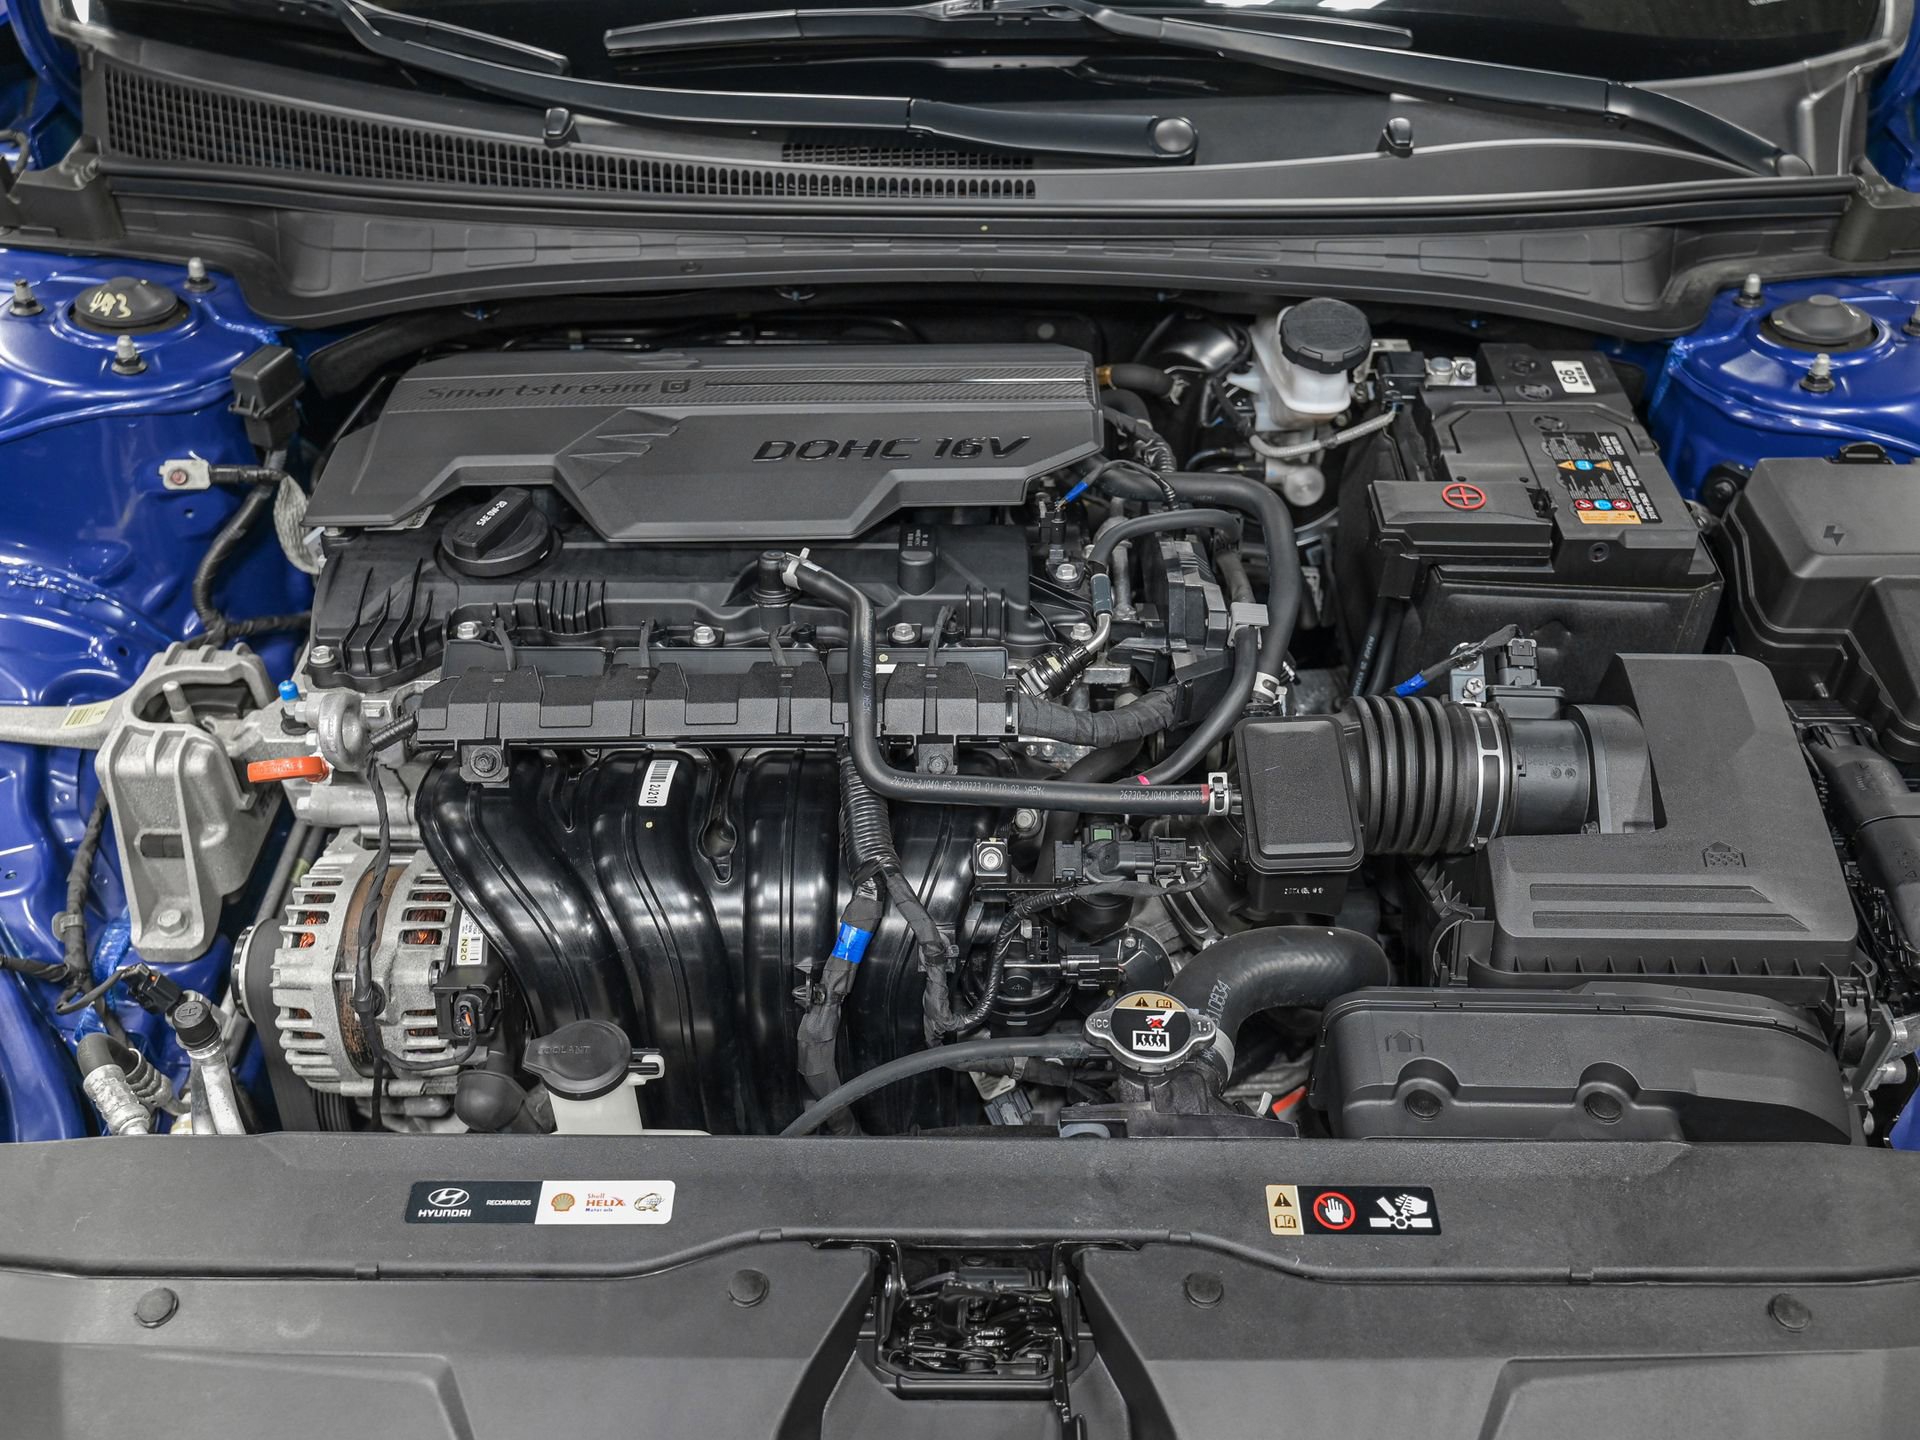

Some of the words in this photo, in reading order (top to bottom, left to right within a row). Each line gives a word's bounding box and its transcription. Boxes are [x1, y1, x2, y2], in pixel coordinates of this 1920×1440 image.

[1559, 369, 1579, 385] G6
[425, 381, 652, 400] Smartstream
[752, 438, 921, 463] DOHC
[934, 435, 1032, 459] 16V
[476, 515, 492, 527] SAE
[646, 784, 661, 804] 2J210
[1119, 790, 1167, 801] 26730-2J040
[1170, 790, 1180, 801] HS
[460, 938, 468, 961] N20
[1196, 1021, 1211, 1032] 1.1
[586, 1198, 626, 1207] HELIX
[417, 1209, 472, 1218] HYUNDAI
